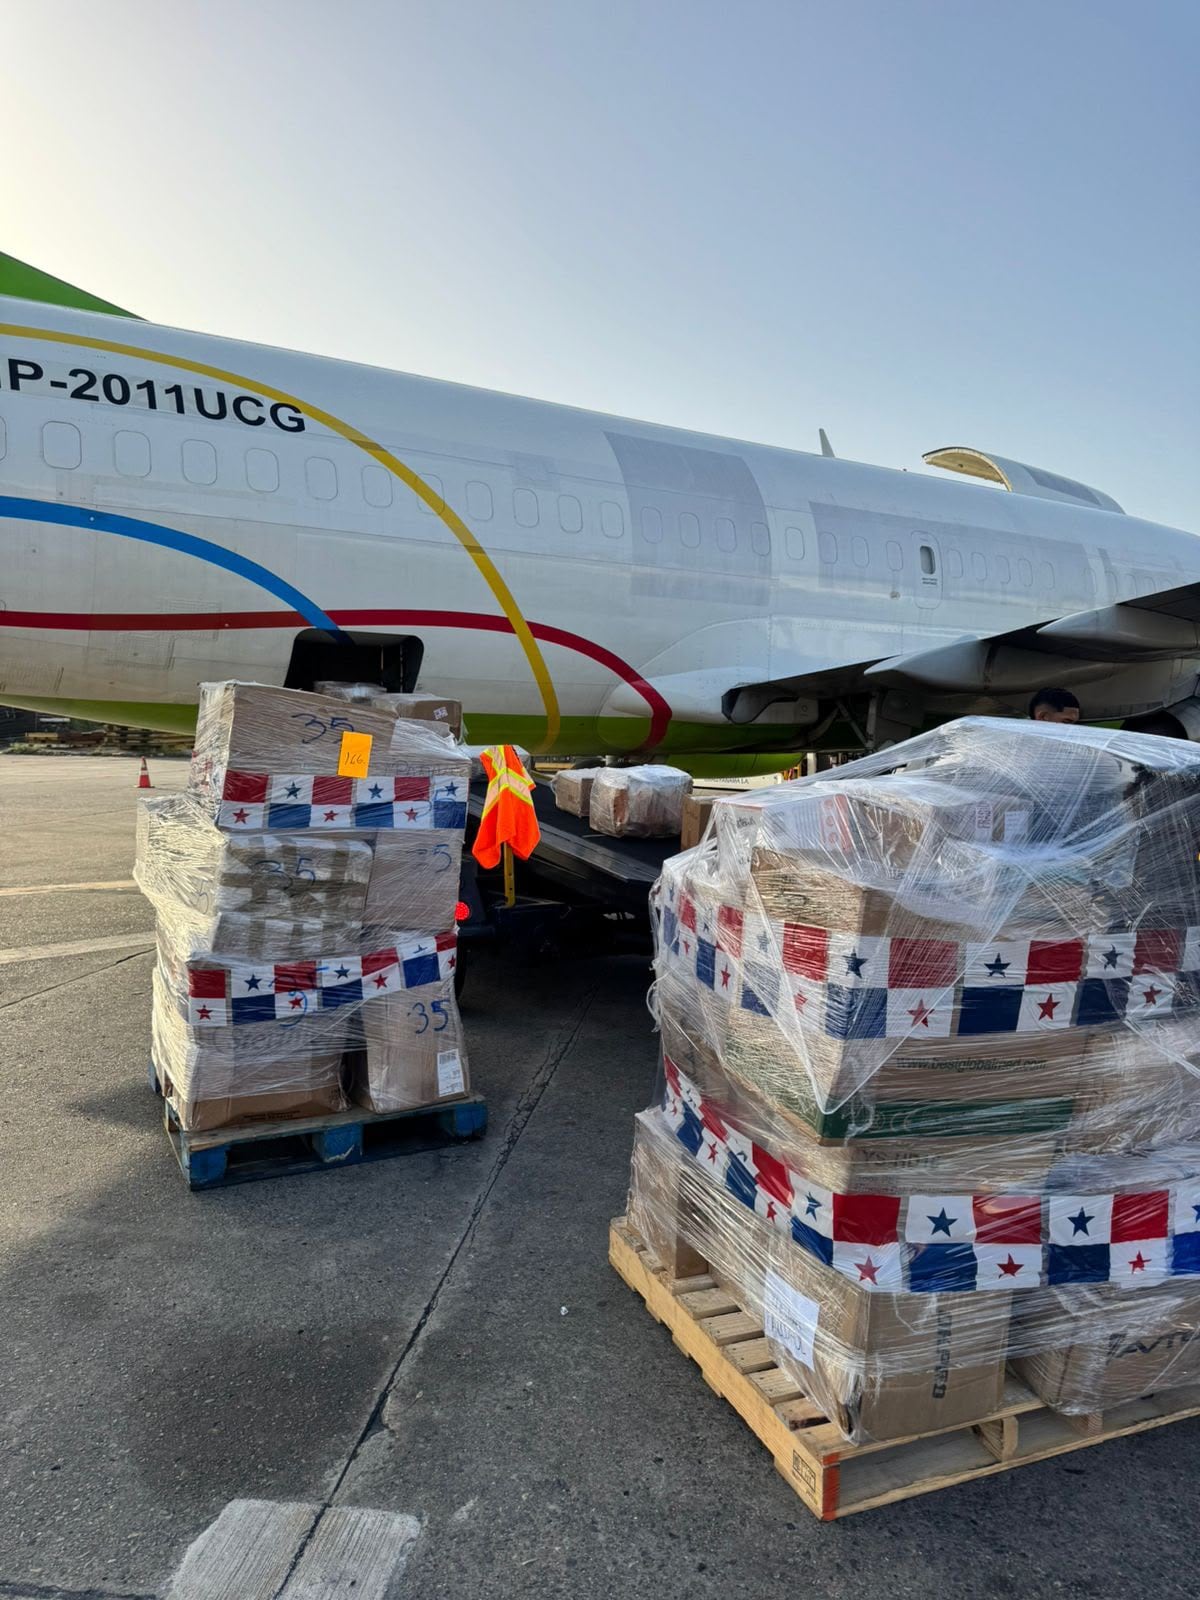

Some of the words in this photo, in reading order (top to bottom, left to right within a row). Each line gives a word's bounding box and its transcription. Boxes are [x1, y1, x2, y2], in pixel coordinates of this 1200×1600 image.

[0, 358, 306, 433] P-2011UCG
[291, 713, 355, 744] 35
[412, 998, 450, 1034] 35
